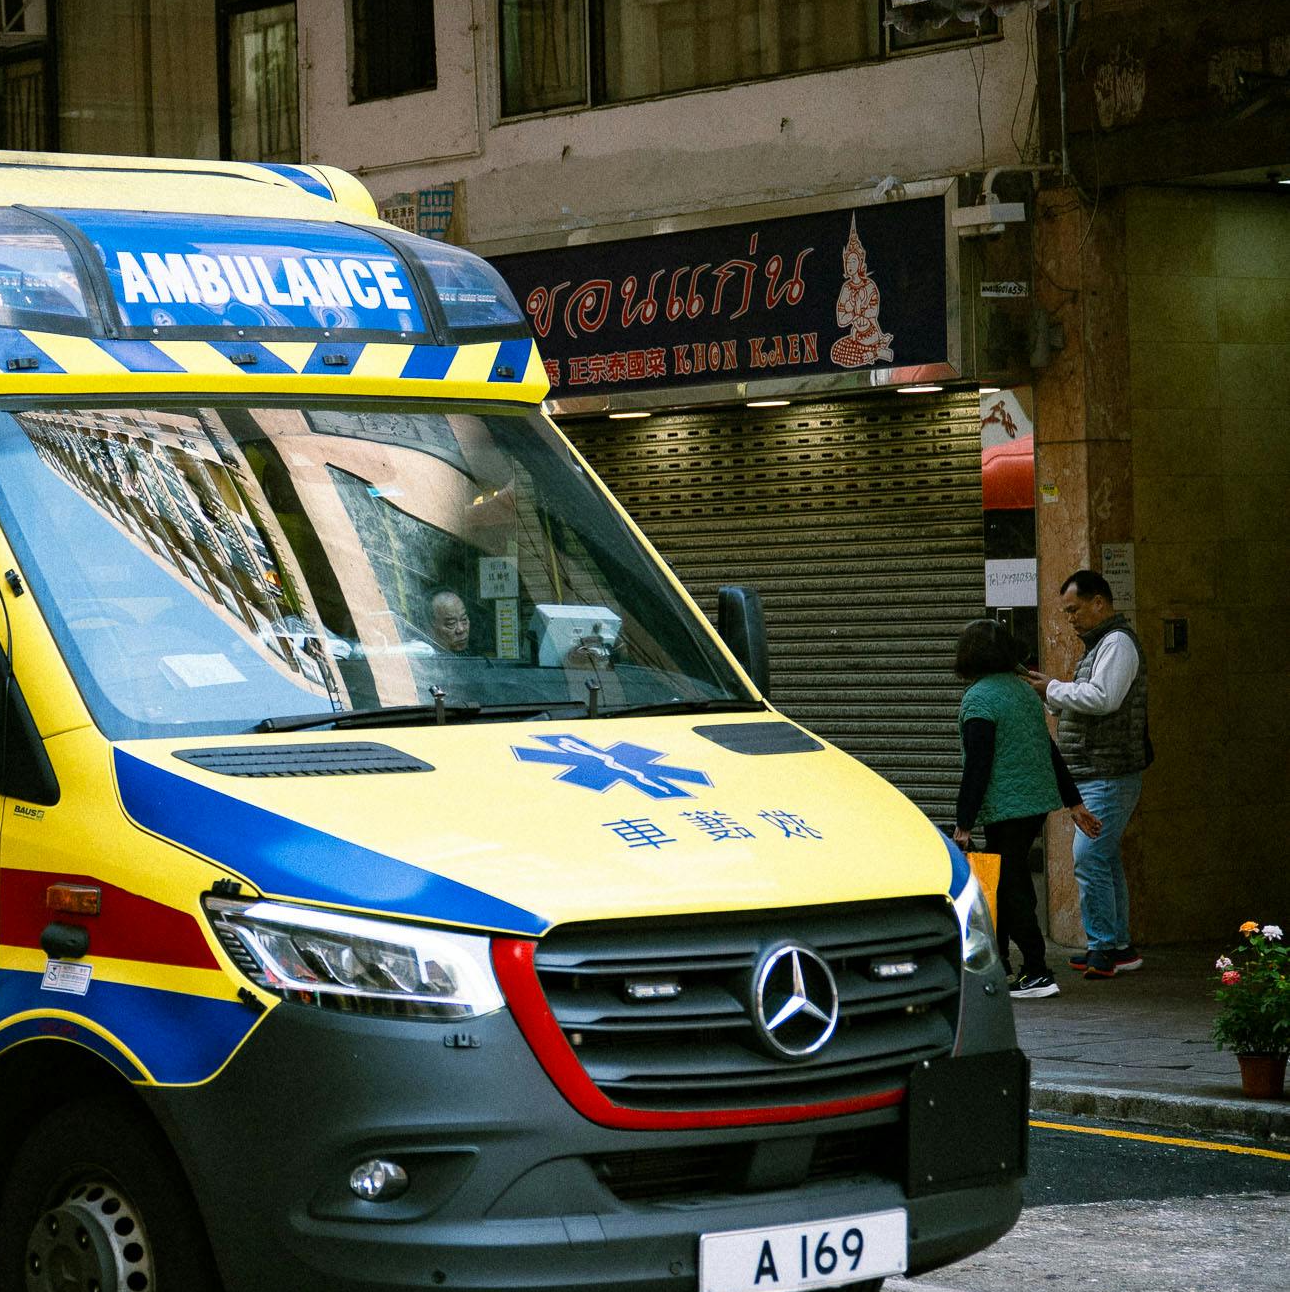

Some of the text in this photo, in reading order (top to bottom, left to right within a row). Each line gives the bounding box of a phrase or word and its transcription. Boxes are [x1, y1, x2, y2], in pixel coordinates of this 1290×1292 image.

[116, 250, 412, 311] AMBULANCE
[526, 232, 815, 339] ขอนแก่น
[568, 347, 667, 386] 正宗泰國菜
[673, 332, 819, 376] KHON KAEN
[14, 805, 37, 816] BAUS
[753, 1227, 864, 1284] A 169
